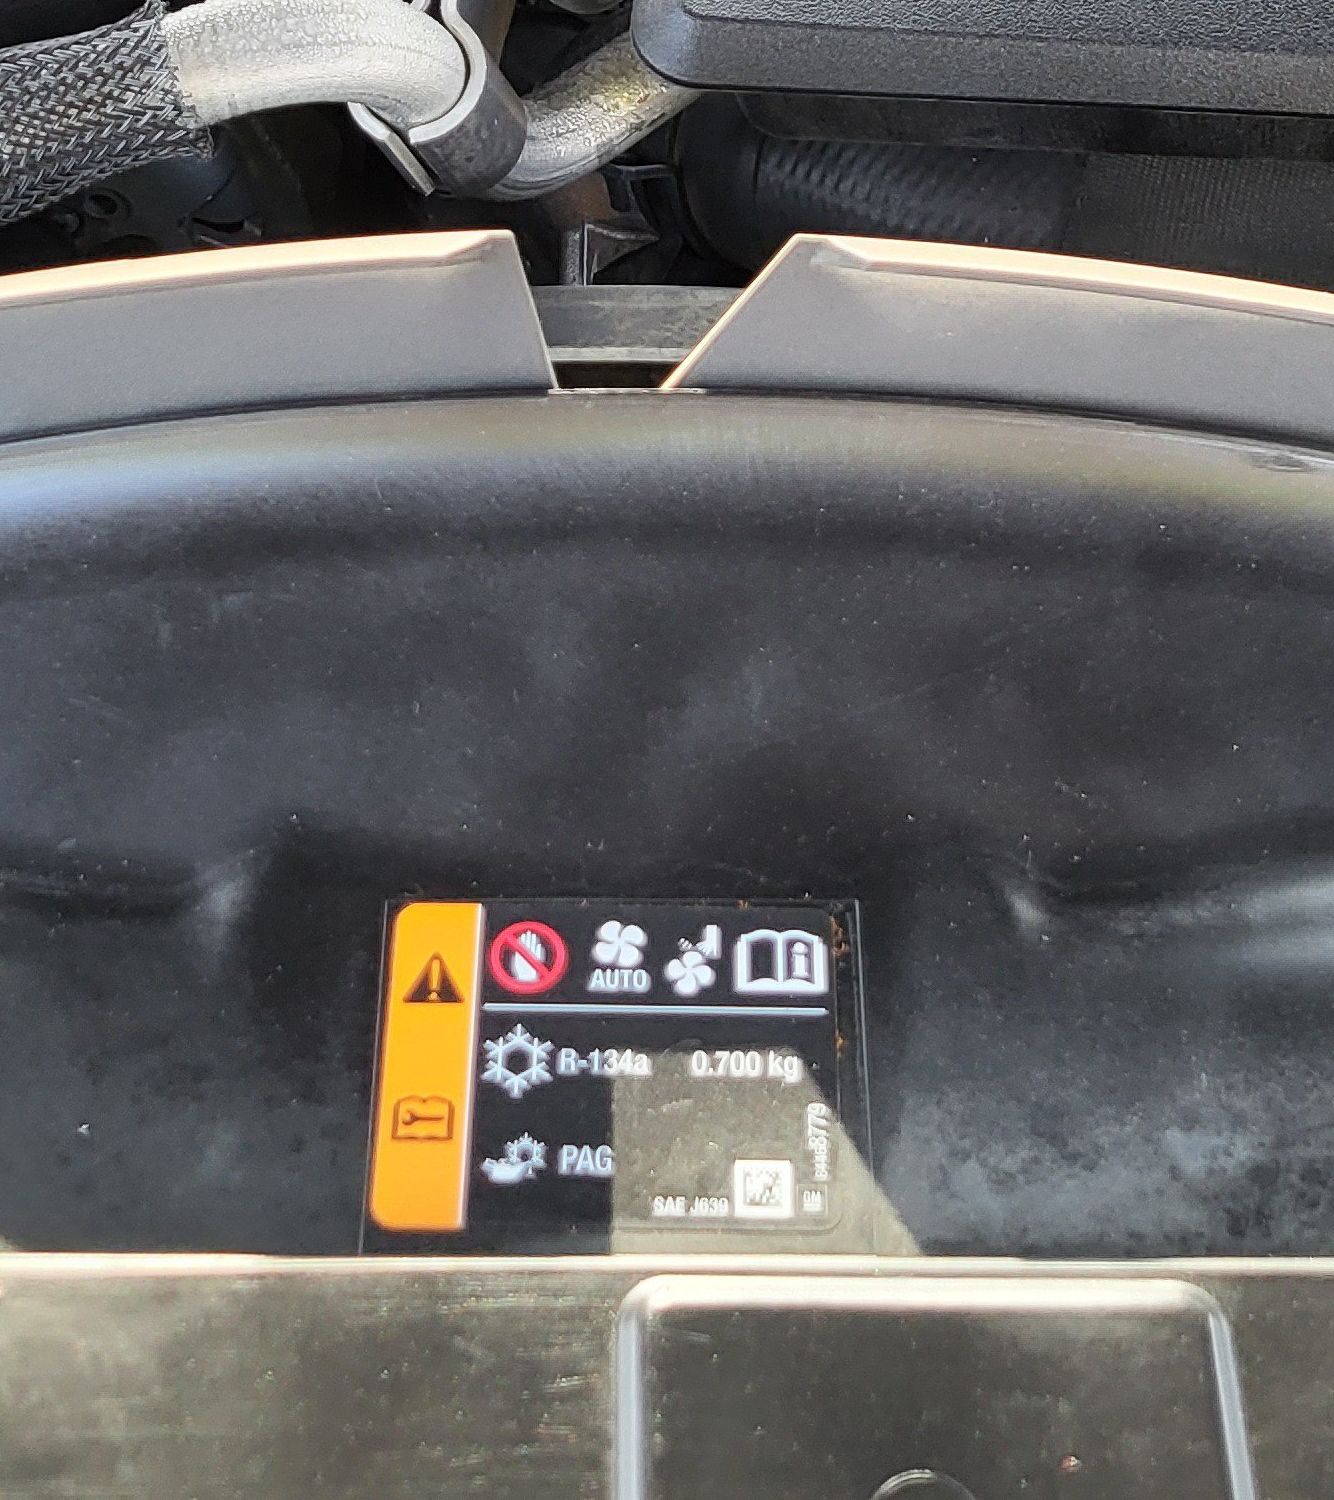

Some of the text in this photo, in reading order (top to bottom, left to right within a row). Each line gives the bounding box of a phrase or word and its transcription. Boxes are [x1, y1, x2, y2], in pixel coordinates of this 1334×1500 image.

[589, 968, 648, 990] AUTO
[558, 1048, 800, 1082] R-134a 0.700 kg
[561, 1144, 613, 1175] PAG
[653, 1195, 729, 1216] SAE J639
